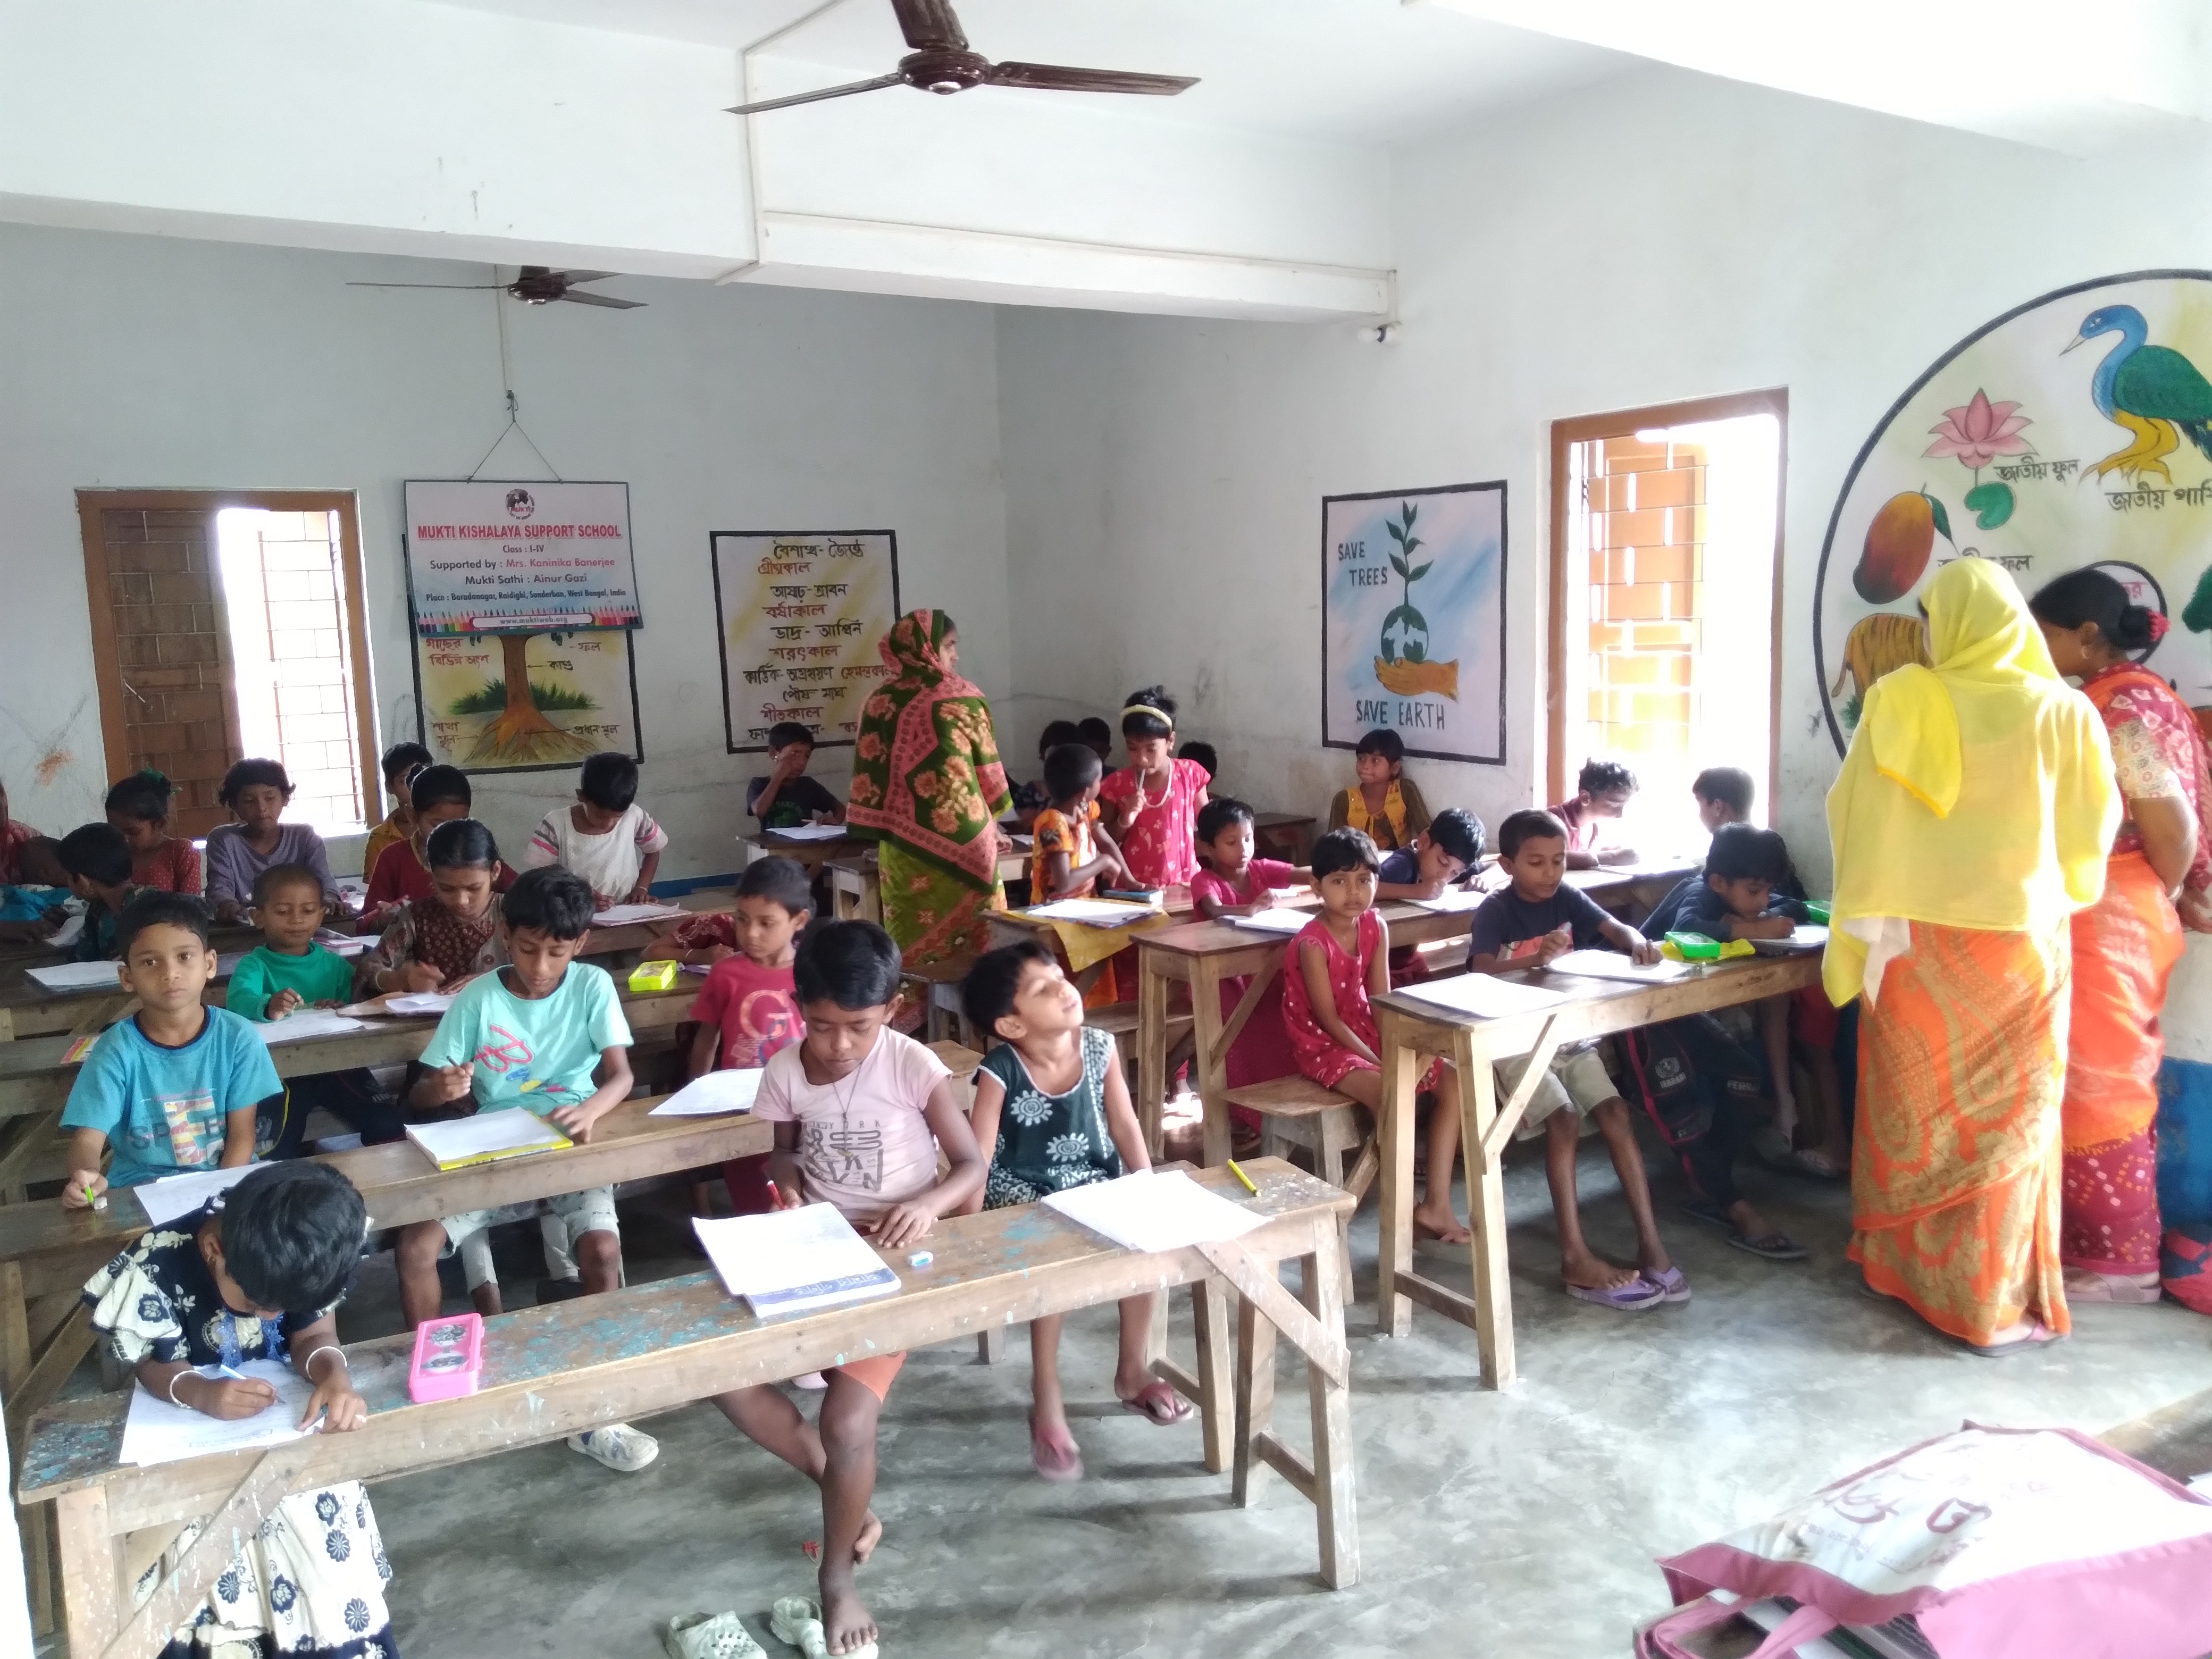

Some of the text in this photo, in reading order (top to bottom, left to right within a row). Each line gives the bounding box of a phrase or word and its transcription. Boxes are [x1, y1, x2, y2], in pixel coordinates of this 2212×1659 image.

[2105, 481, 2170, 514] জাতীয়
[418, 524, 621, 539] MUKTI KISHALAYA SUPPORT SCHOOL
[502, 544, 522, 554] Class
[530, 544, 544, 553] I-IV
[1338, 541, 1365, 561] SAVE
[430, 559, 482, 571] Supported
[485, 559, 497, 570] by
[506, 559, 527, 567] Mrs.
[530, 558, 572, 567] Kaninika
[574, 558, 616, 568] Banerjee
[465, 575, 495, 585] Mukti
[498, 574, 524, 584] Sathi
[533, 574, 562, 583] Ainur
[565, 573, 588, 583] Gazi
[1348, 566, 1388, 586] TREES
[426, 593, 445, 601] Place
[529, 590, 567, 599] Sunderban,
[584, 588, 609, 598] Bengal,
[499, 616, 568, 625] www.muktiweb.org
[1356, 699, 1445, 730] SAVE EARTH
